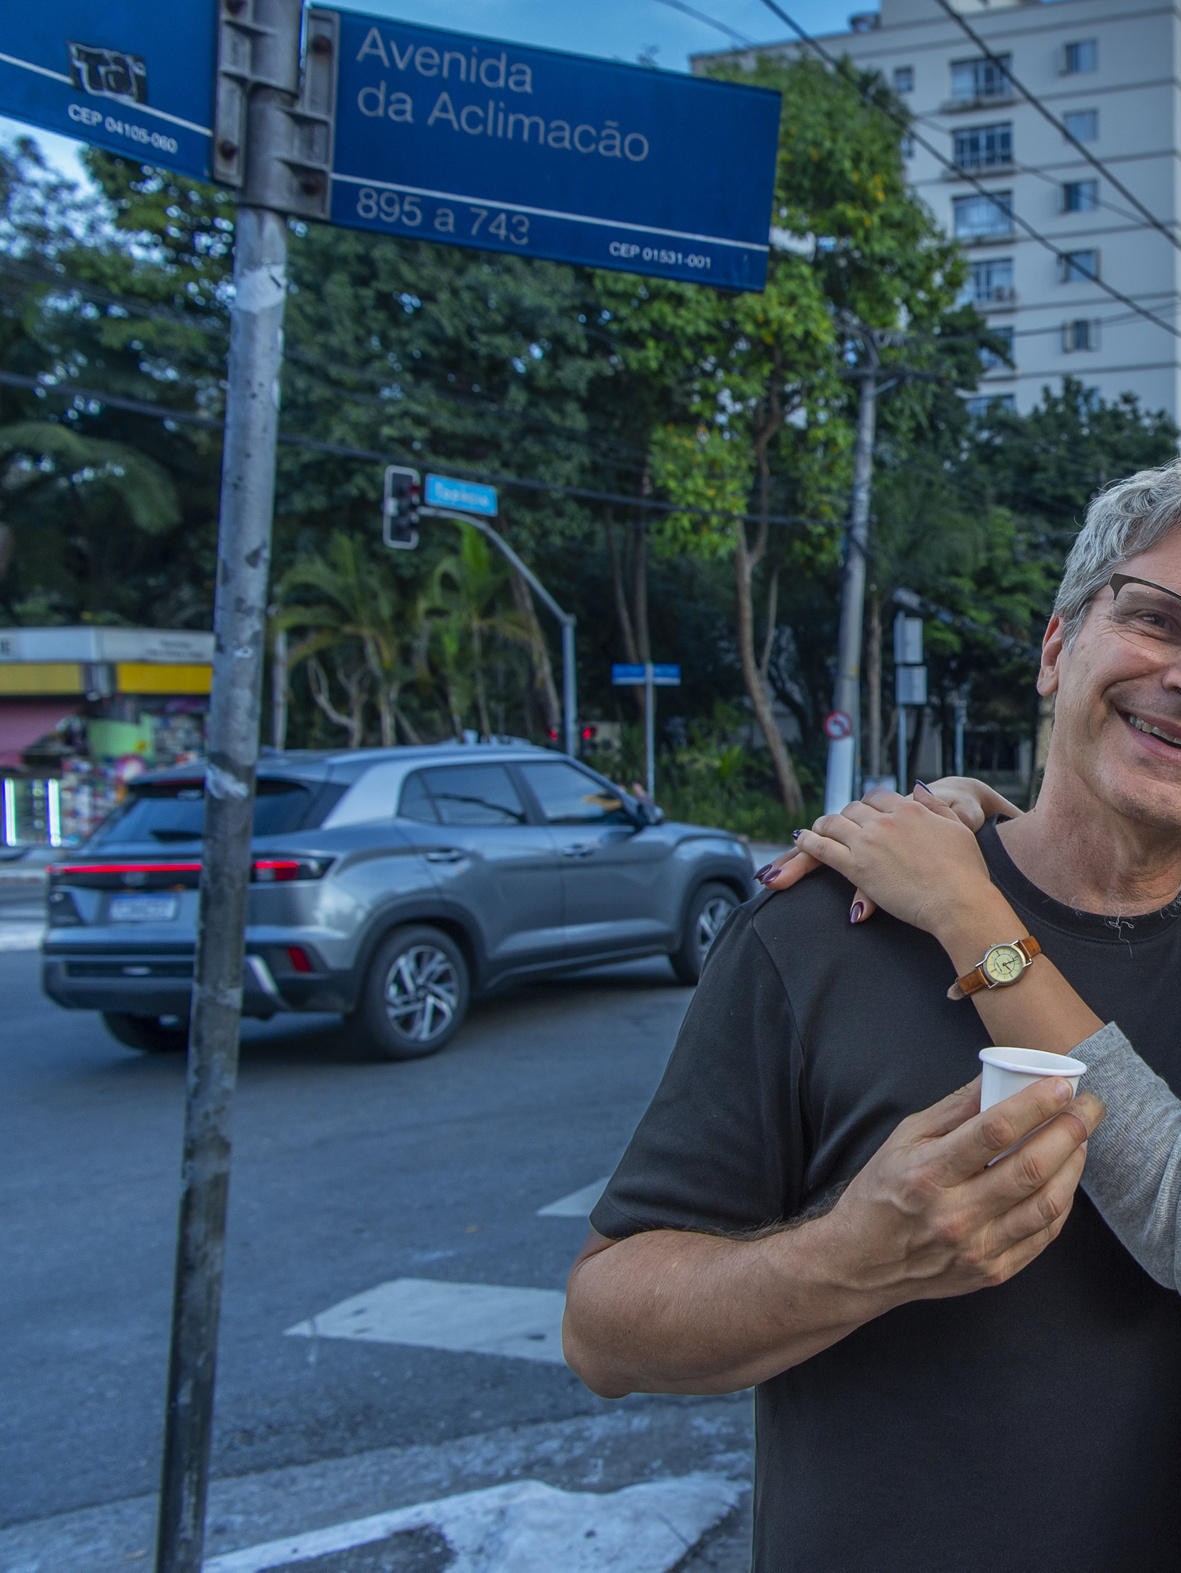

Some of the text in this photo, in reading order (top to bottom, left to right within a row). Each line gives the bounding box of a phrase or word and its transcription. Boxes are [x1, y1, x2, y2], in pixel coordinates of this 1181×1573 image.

[355, 26, 534, 94] Avenida
[67, 103, 102, 127] CEP
[356, 79, 414, 124] da
[356, 187, 531, 246] 895 a 743
[608, 241, 712, 270] CEP 01531-001
